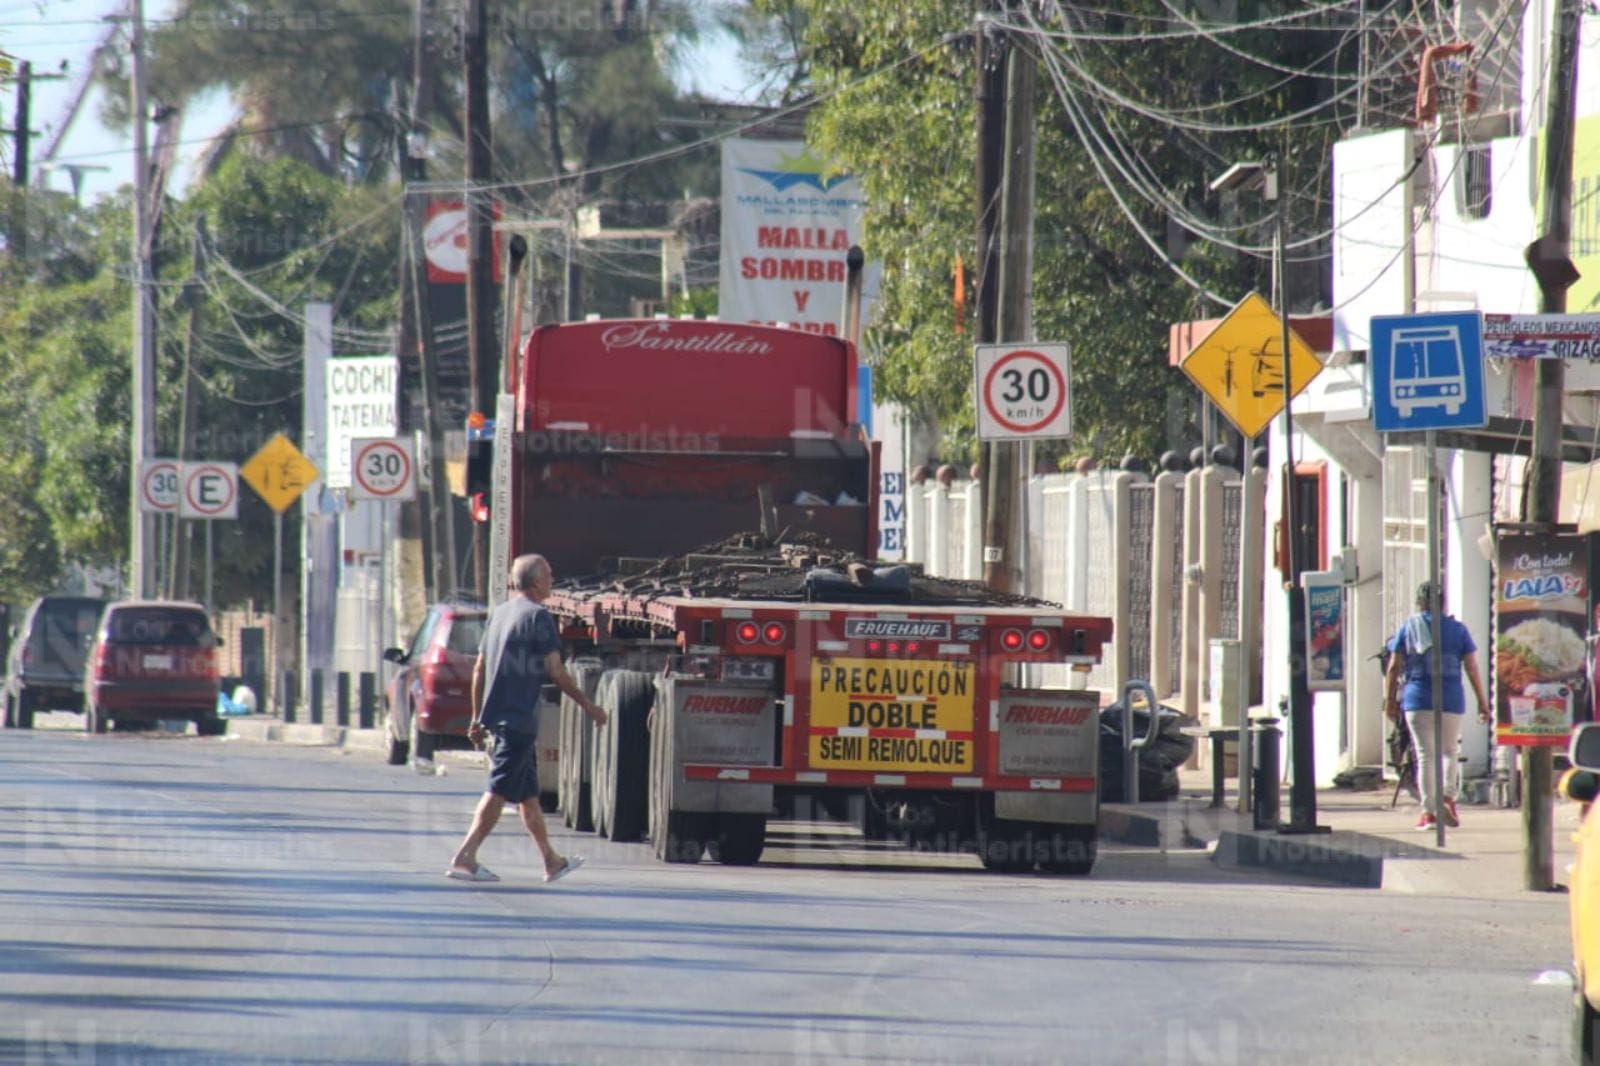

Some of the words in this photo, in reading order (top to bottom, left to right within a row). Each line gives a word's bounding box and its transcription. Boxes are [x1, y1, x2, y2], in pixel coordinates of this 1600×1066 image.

[757, 225, 849, 251] MALLA
[740, 256, 846, 282] SOMBR
[792, 289, 810, 314] Y
[601, 323, 774, 354] Santillán
[1486, 319, 1543, 333] PETROLEOS
[331, 365, 396, 395] COCHI
[1002, 368, 1051, 403] 30
[1007, 406, 1044, 418] km/h
[367, 453, 400, 476] 30
[153, 473, 178, 493] 30
[200, 475, 222, 505] E
[1505, 575, 1564, 600] LALA
[854, 621, 941, 636] FRUEHAUF
[820, 663, 967, 696] PRECAUCIÓN
[848, 701, 938, 730] DOBLE
[820, 736, 862, 761] SEMI
[868, 738, 966, 765] REMOLQUE
